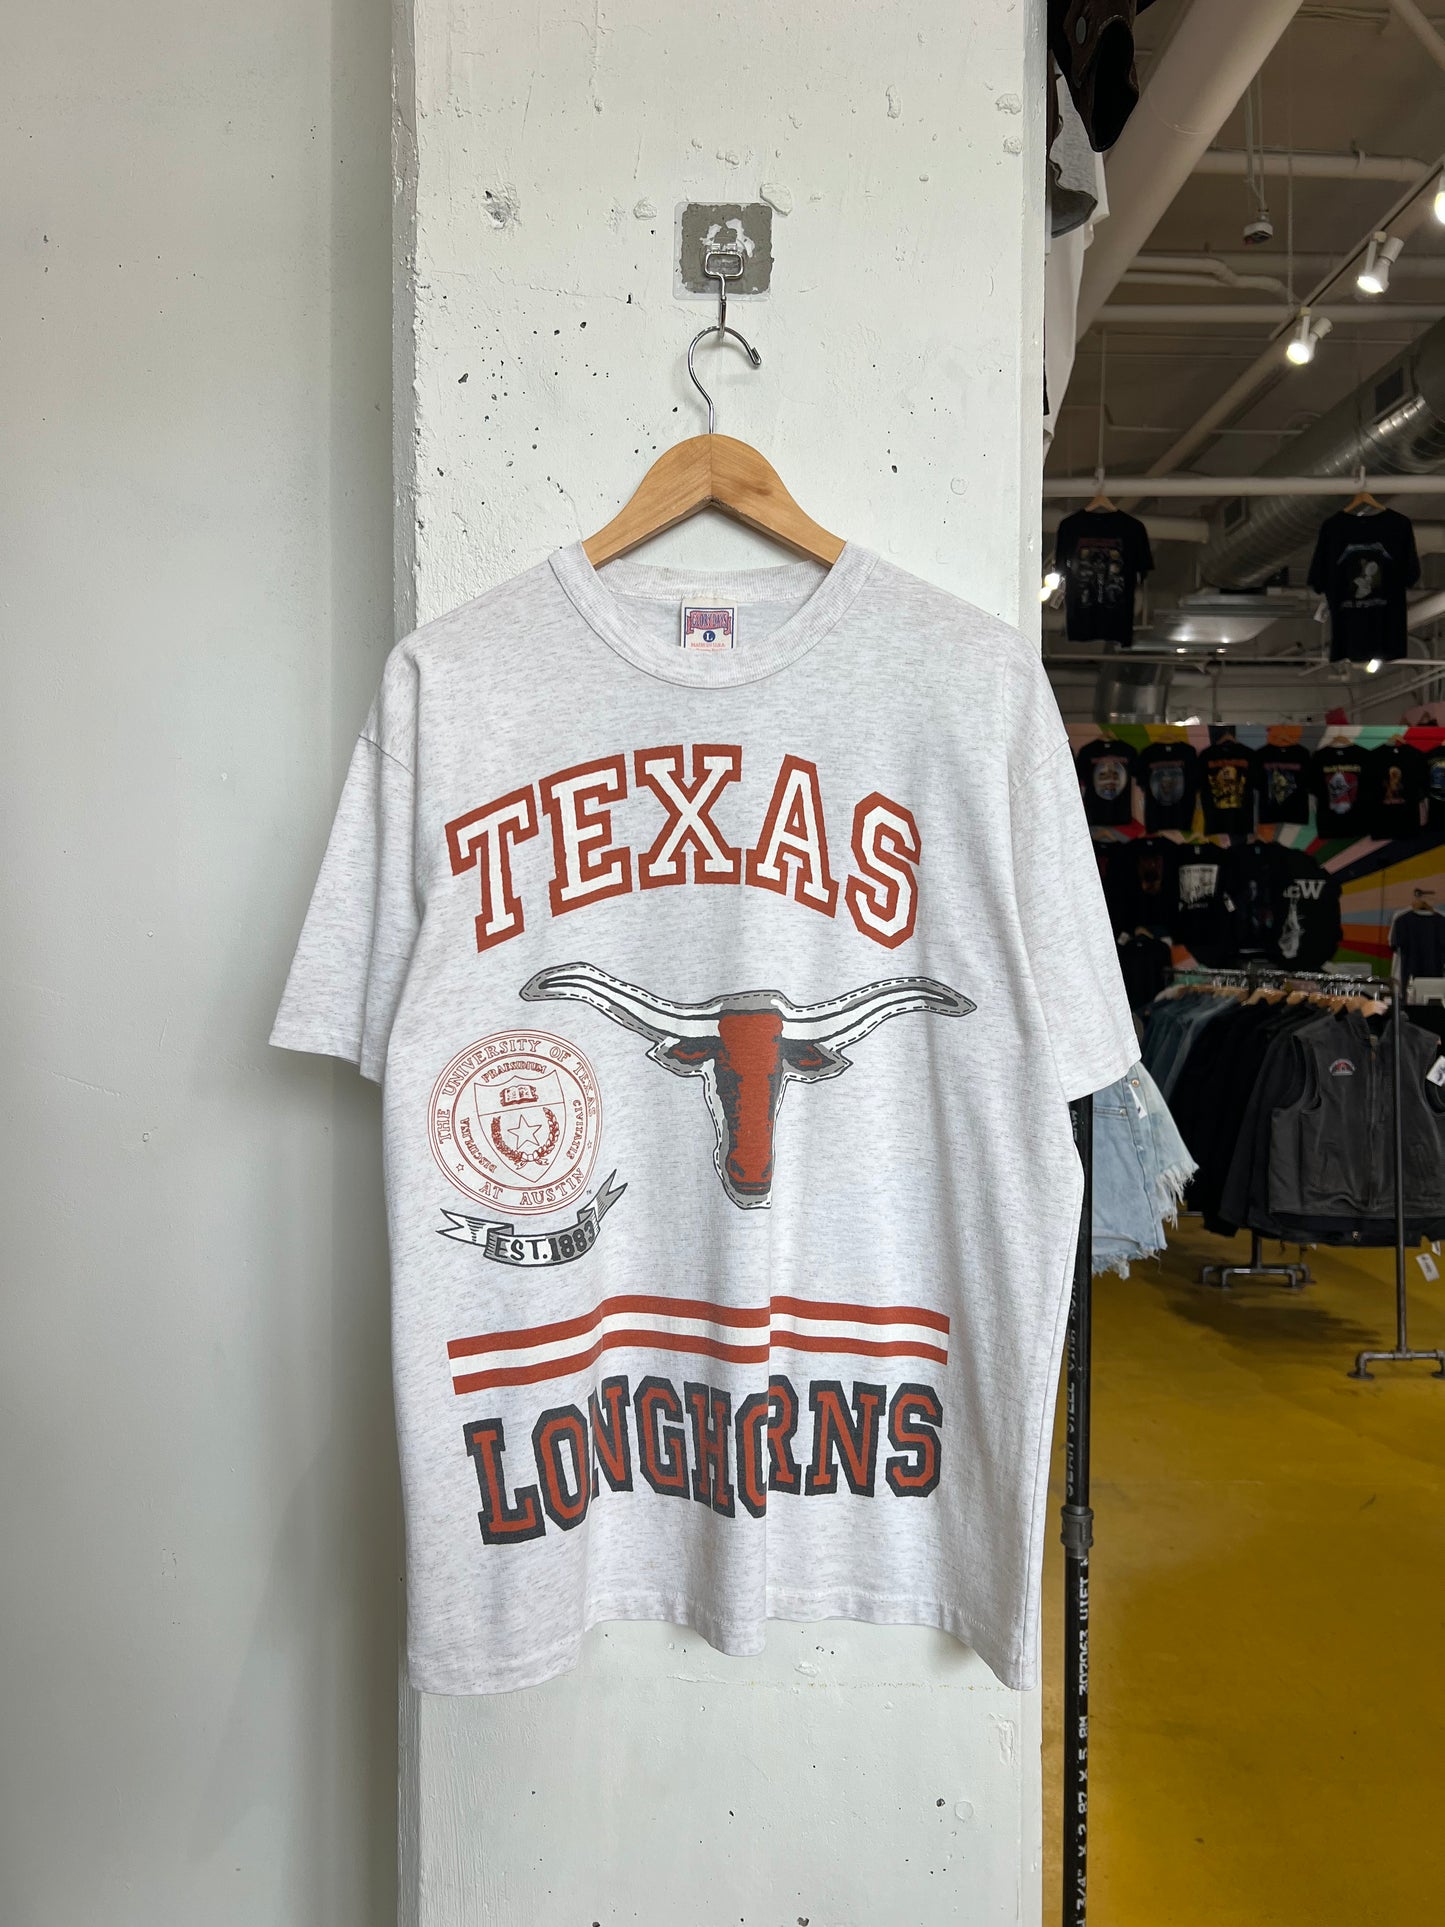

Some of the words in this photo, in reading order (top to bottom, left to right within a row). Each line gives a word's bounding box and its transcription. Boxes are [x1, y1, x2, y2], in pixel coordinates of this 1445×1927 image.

[706, 632, 713, 641] L
[444, 744, 921, 952] TEXAS
[441, 1038, 542, 1096] UNIVERSITY
[481, 1060, 547, 1084] PRAESIDIUM
[549, 1045, 572, 1062] OF
[573, 1061, 597, 1118] TEXAS
[436, 1108, 452, 1145] THE
[459, 1116, 498, 1174] DISCIPLINA
[566, 1099, 582, 1161] CIVITATIS
[478, 1181, 504, 1200] AT
[519, 1167, 586, 1206] AUSTIN
[463, 1375, 943, 1545] LONGHORNS
